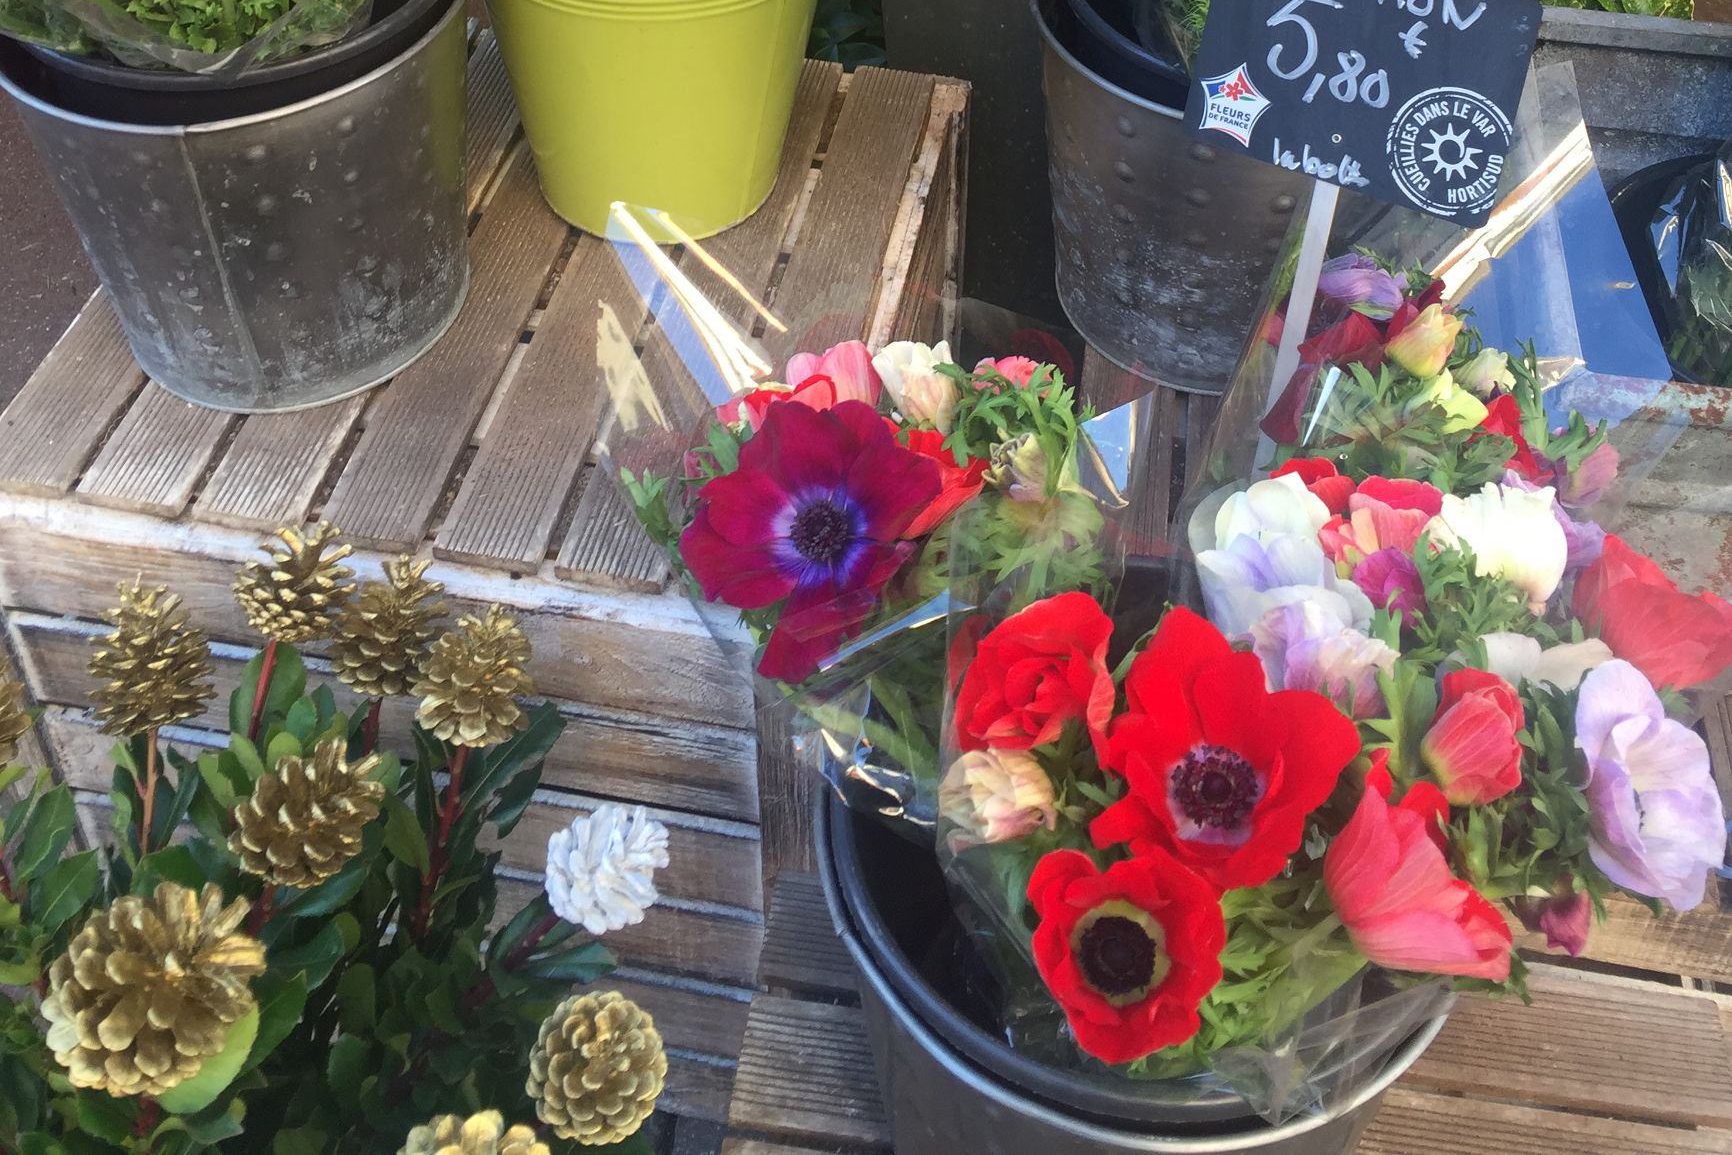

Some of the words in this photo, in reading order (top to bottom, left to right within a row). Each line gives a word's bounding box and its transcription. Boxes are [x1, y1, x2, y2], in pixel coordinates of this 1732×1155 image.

[1208, 112, 1219, 121] DE
[1219, 115, 1249, 130] FRANCE
[1210, 102, 1251, 122] FLEURS
[1413, 100, 1450, 126] DANS
[1453, 101, 1471, 119] LE
[1471, 110, 1497, 138] VAR
[1400, 123, 1430, 191] CUEILLIES
[1447, 154, 1504, 203] HORTISUD
